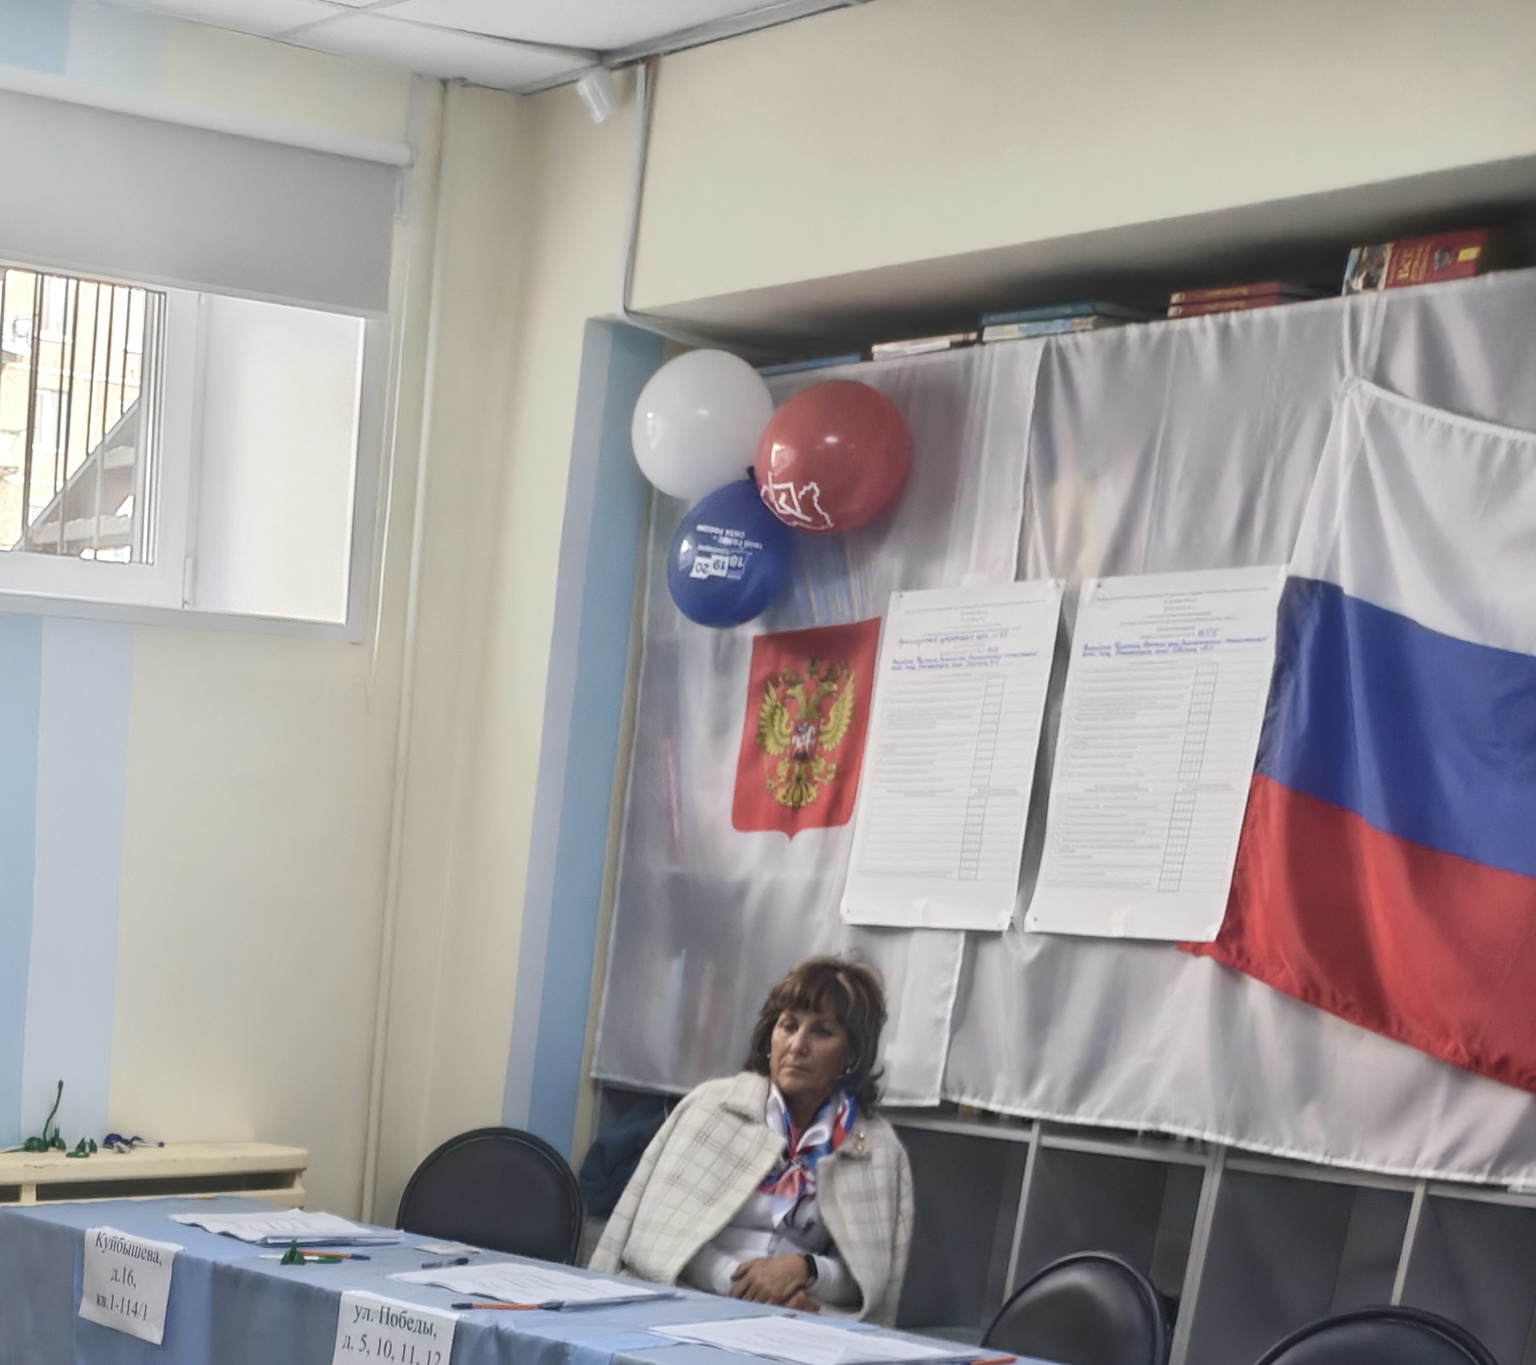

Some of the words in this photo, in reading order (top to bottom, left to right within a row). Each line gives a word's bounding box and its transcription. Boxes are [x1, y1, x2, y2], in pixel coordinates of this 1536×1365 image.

[95, 1231, 162, 1266] Куйбышева,
[353, 1304, 374, 1324] ул.
[379, 1305, 438, 1341] Победы,
[342, 1334, 354, 1351] д.
[358, 1333, 370, 1358] 5,
[376, 1337, 395, 1363] 10,
